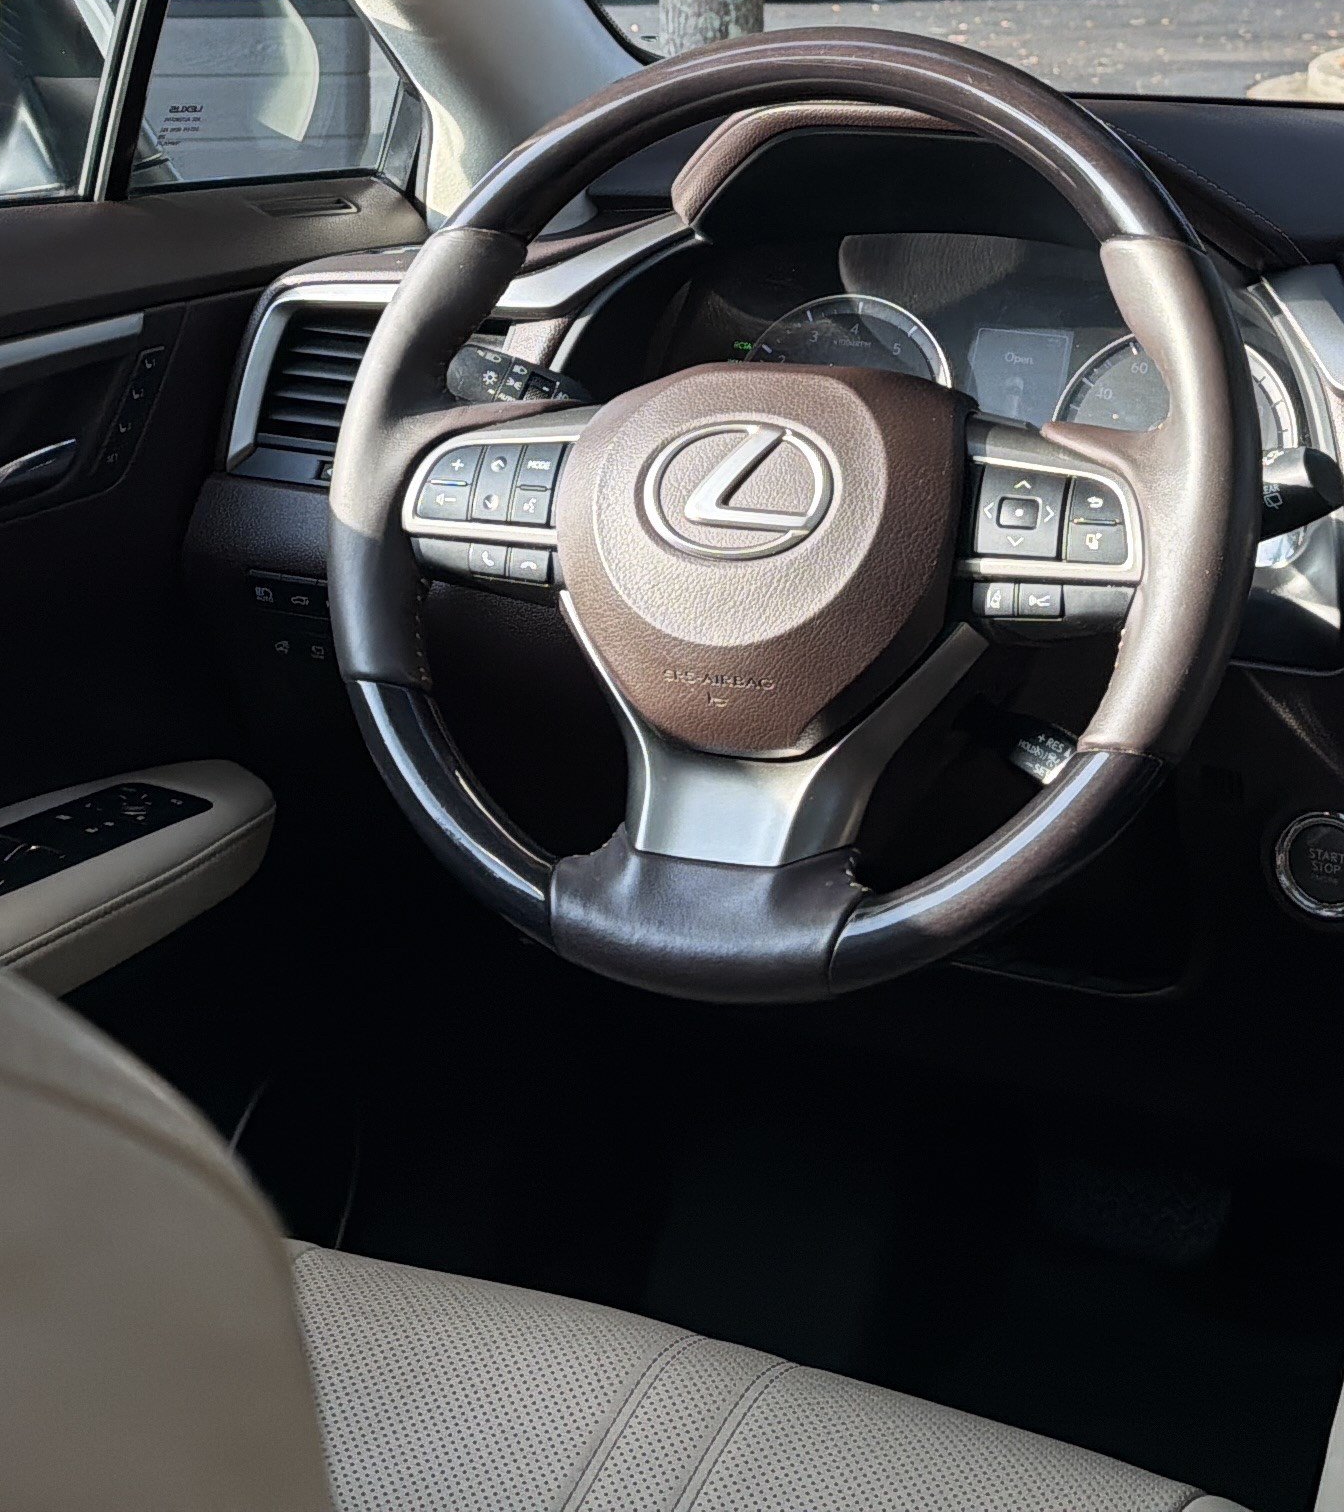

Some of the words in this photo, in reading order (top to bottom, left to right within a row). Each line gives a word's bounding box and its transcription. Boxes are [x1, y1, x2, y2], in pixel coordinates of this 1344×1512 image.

[850, 322, 859, 335] 4
[810, 330, 819, 343] 3
[892, 342, 902, 356] 5
[1005, 352, 1034, 368] Open
[1130, 362, 1148, 376] 60
[1096, 388, 1114, 401] 40
[527, 458, 552, 472] MODE
[1311, 861, 1342, 874] STOP
